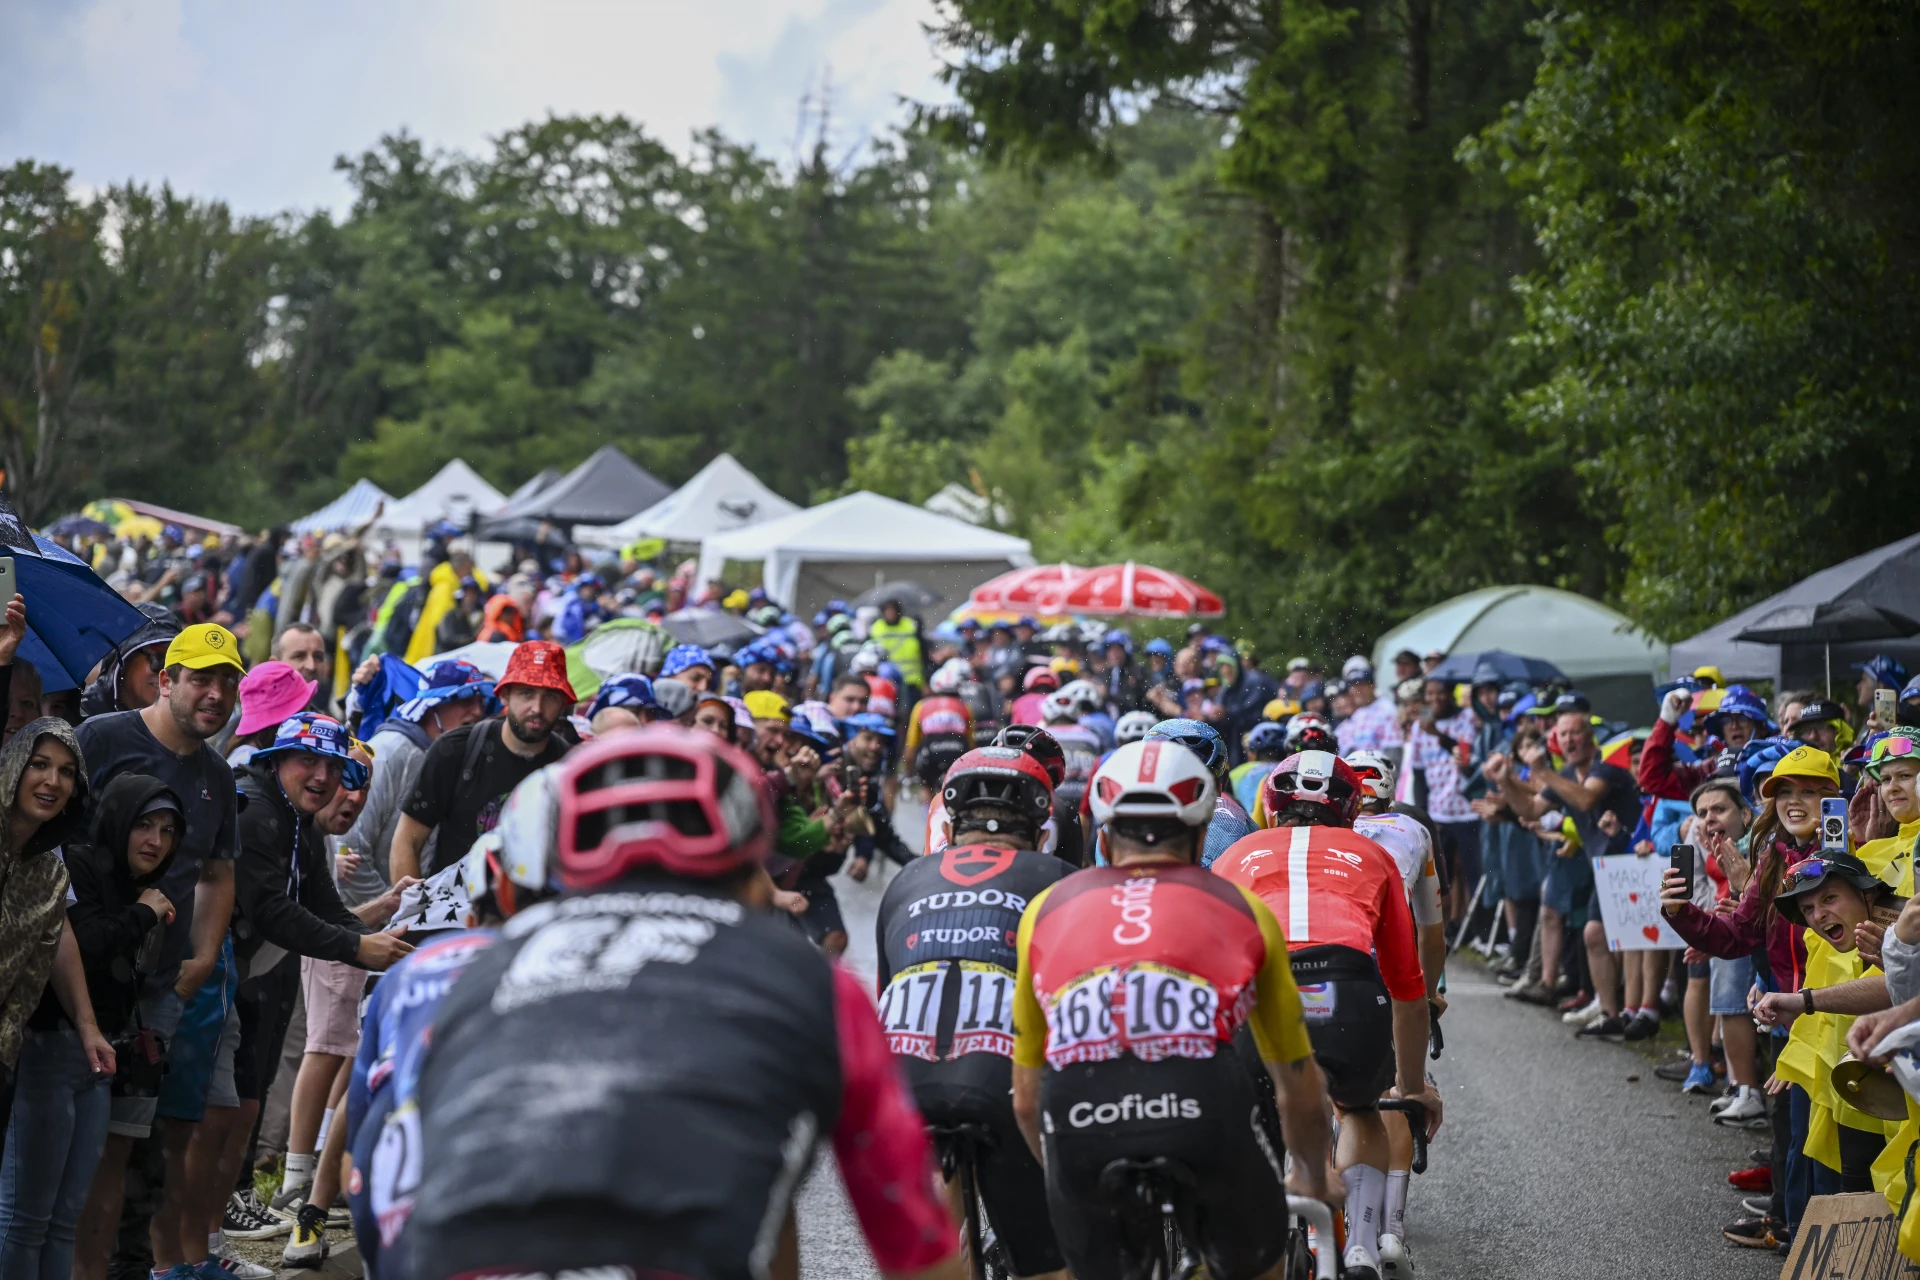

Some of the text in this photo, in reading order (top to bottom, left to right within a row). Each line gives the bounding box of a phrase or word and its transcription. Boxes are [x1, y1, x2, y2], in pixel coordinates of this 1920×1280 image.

[1323, 868, 1349, 878] GOBIK
[1608, 868, 1652, 889] MARC
[908, 888, 1027, 918] TUDOR
[1111, 877, 1158, 946] Cofidis
[921, 926, 1000, 944] TUDOR
[961, 974, 1016, 1034] 11
[1053, 975, 1112, 1047] 168
[1129, 974, 1211, 1035] 168
[1303, 1005, 1331, 1014] nergies
[887, 1036, 932, 1061] LUX
[1068, 1092, 1202, 1128] Cofidis
